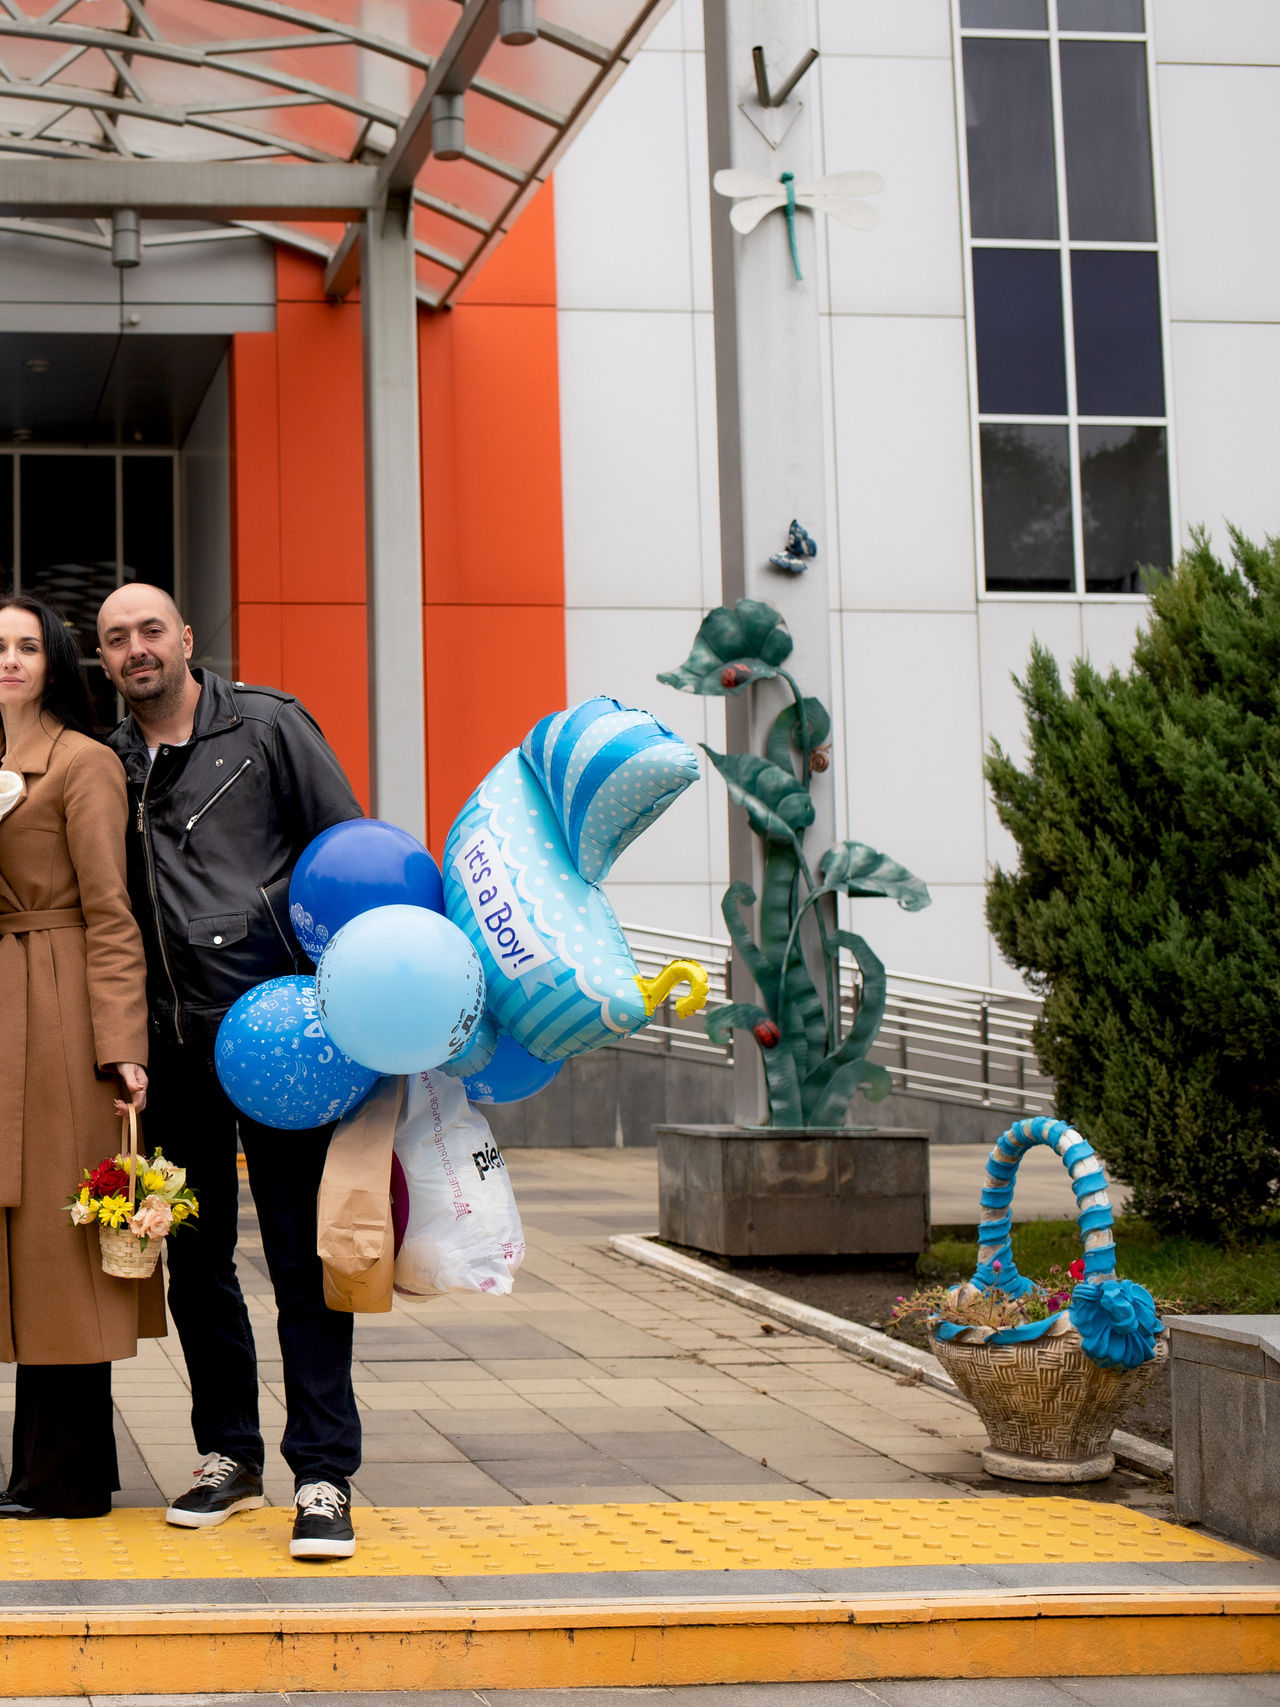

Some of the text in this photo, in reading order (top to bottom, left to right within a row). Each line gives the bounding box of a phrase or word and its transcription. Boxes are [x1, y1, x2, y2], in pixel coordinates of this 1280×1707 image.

[478, 885, 498, 907] a
[484, 901, 535, 969] Boy!
[425, 1082, 436, 1097] НА
[449, 1176, 463, 1199] ЕЩЕ
